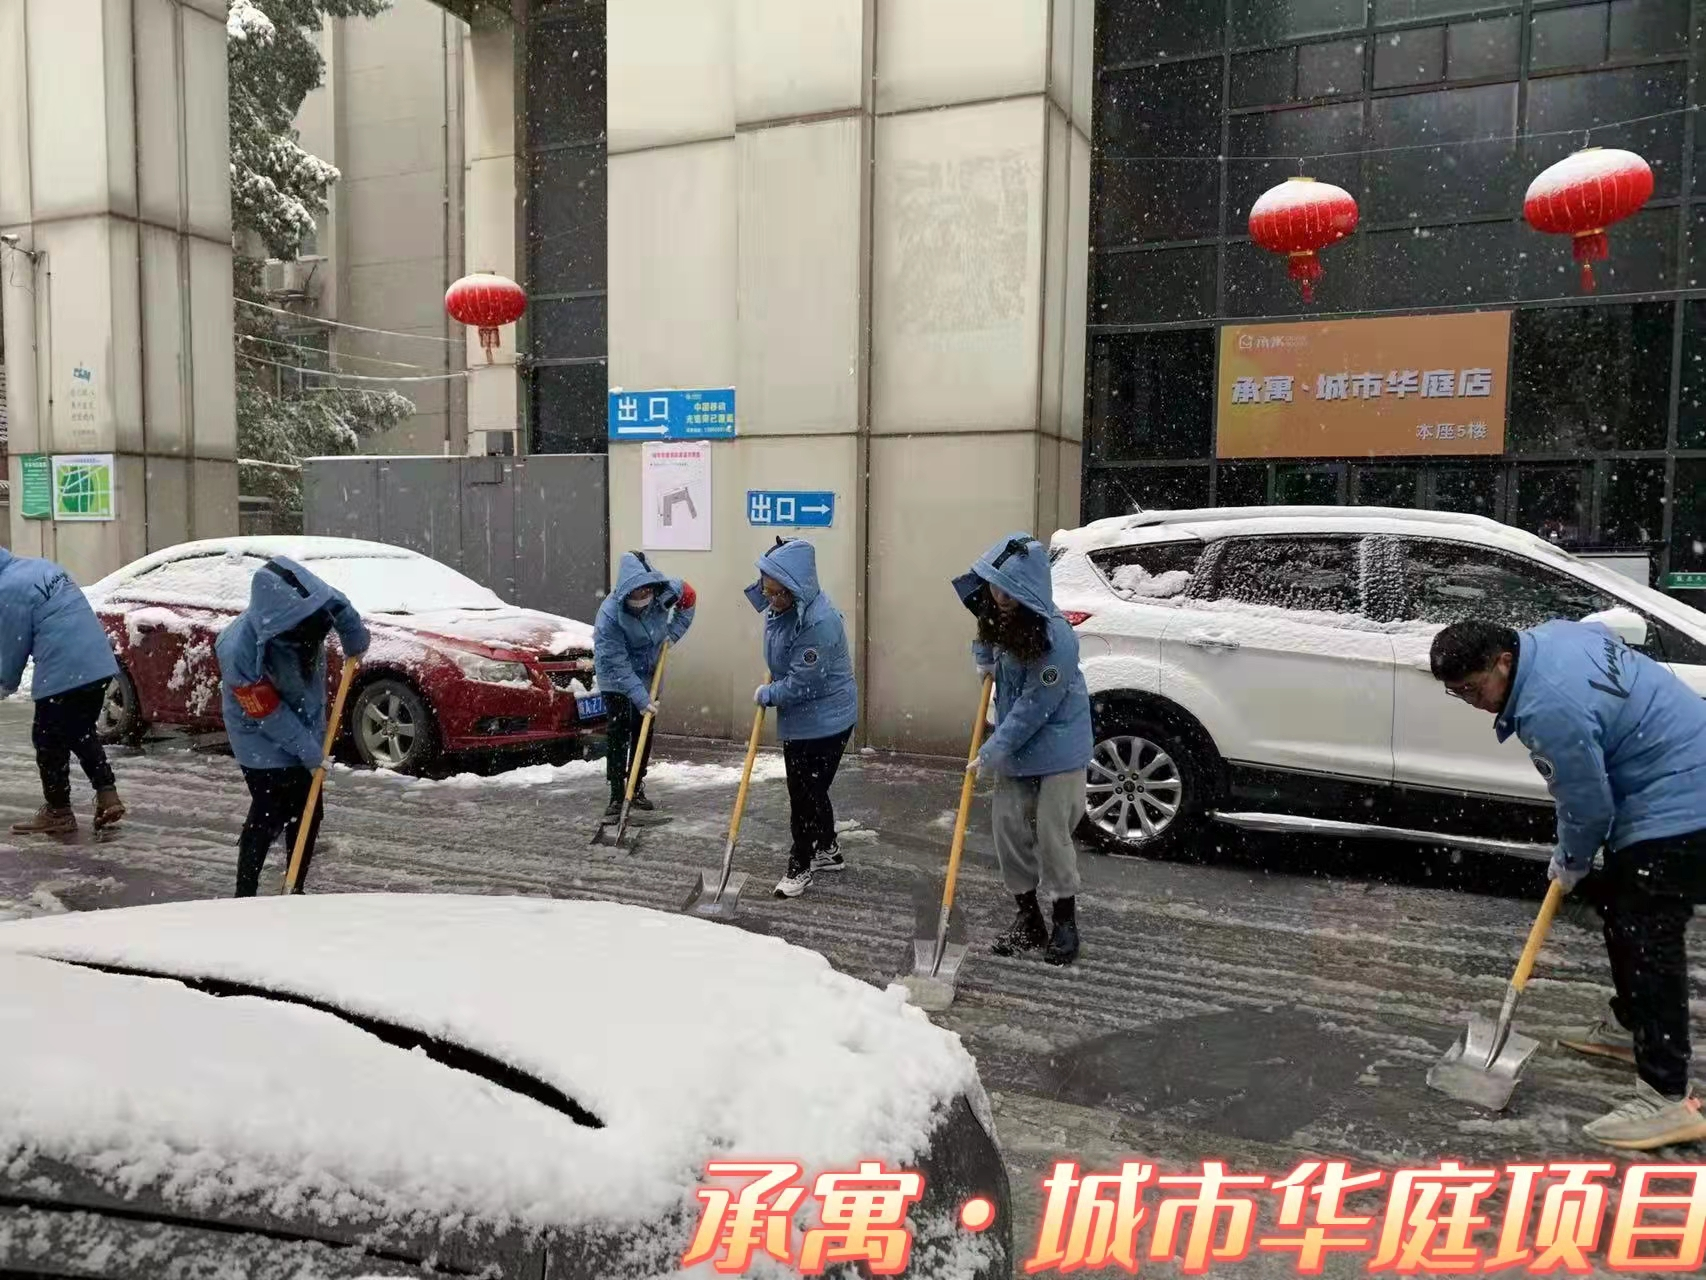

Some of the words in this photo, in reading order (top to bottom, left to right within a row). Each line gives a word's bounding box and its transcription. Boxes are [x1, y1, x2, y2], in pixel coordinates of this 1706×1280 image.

[1231, 367, 1492, 404] 承寓·城市华庭店
[618, 396, 669, 421] 出口
[1415, 422, 1488, 440] 本座5楼
[751, 493, 796, 523] 出口
